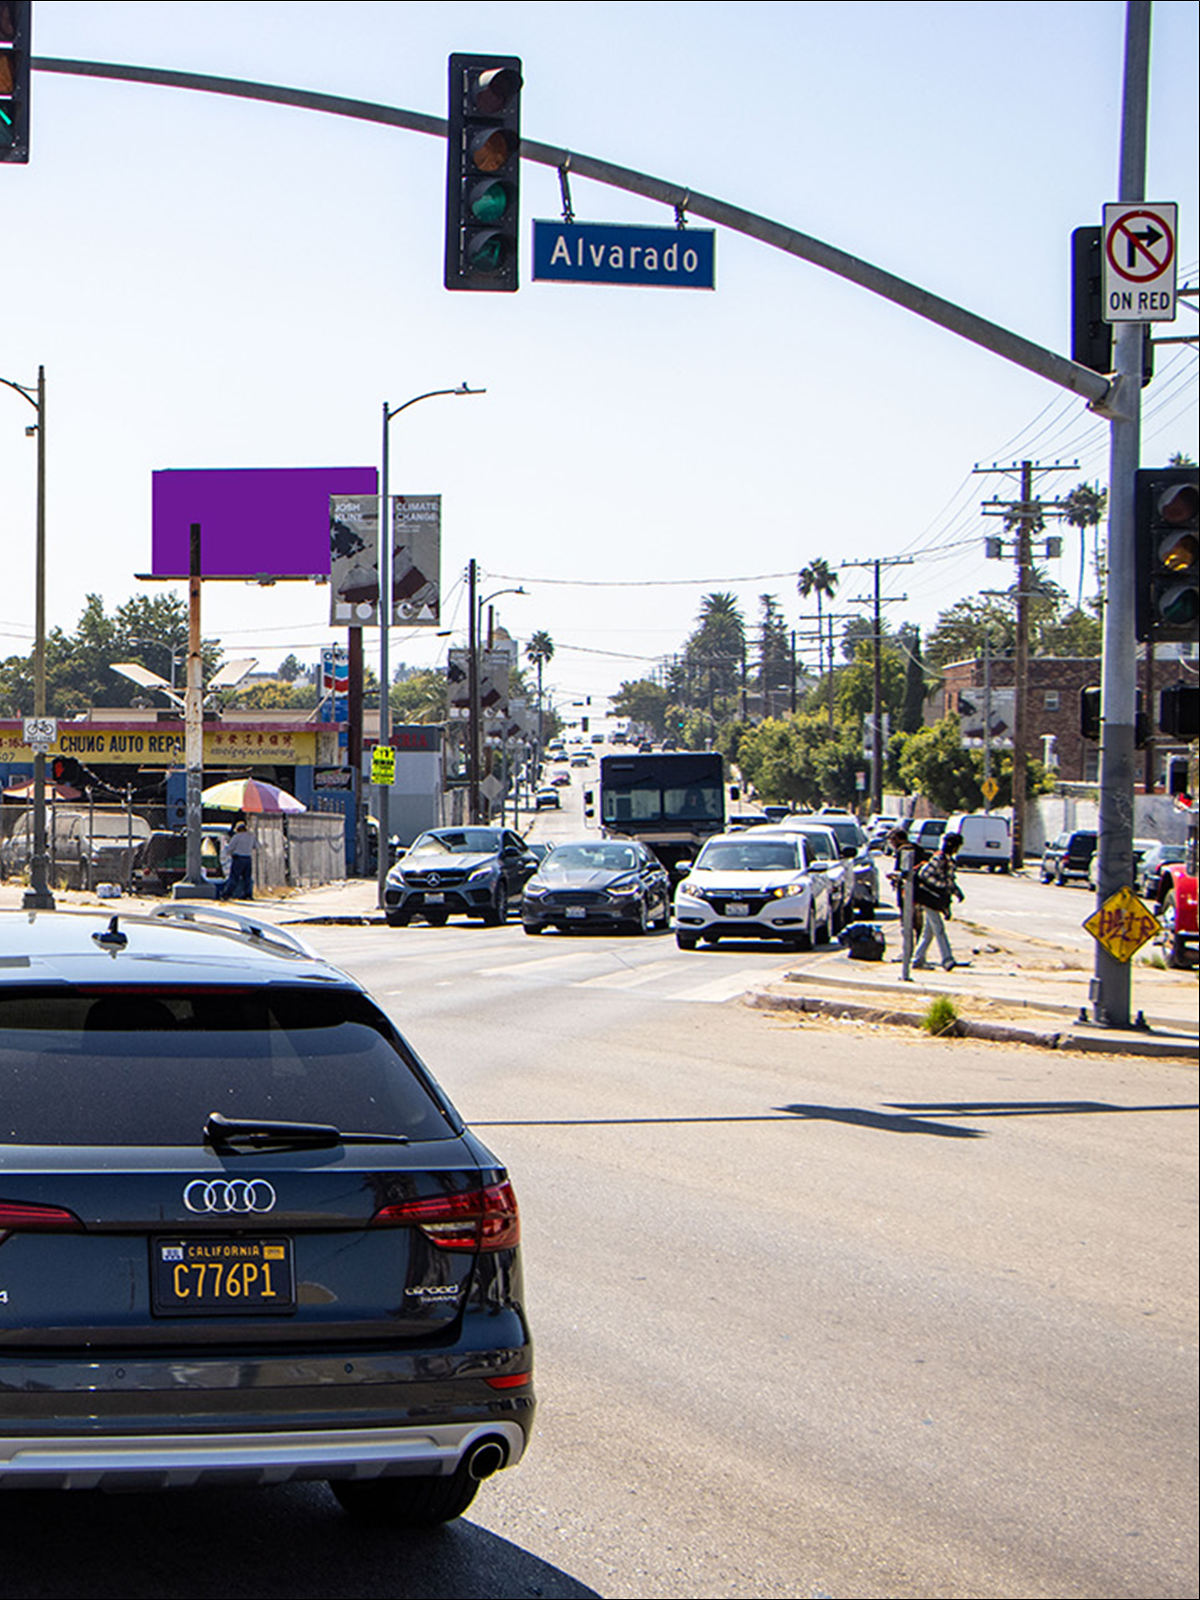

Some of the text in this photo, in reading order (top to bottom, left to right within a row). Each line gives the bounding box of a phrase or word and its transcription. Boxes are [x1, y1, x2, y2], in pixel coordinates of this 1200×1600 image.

[551, 236, 698, 272] Alvarado
[1110, 292, 1170, 310] ON RED
[335, 502, 360, 512] JOSH
[395, 502, 438, 511] CLIMATE
[395, 512, 438, 522] CHANGE
[60, 735, 186, 753] CHUNG AUTO REPAI
[188, 1245, 260, 1258] CALIFORNIA
[173, 1262, 276, 1298] C776P1
